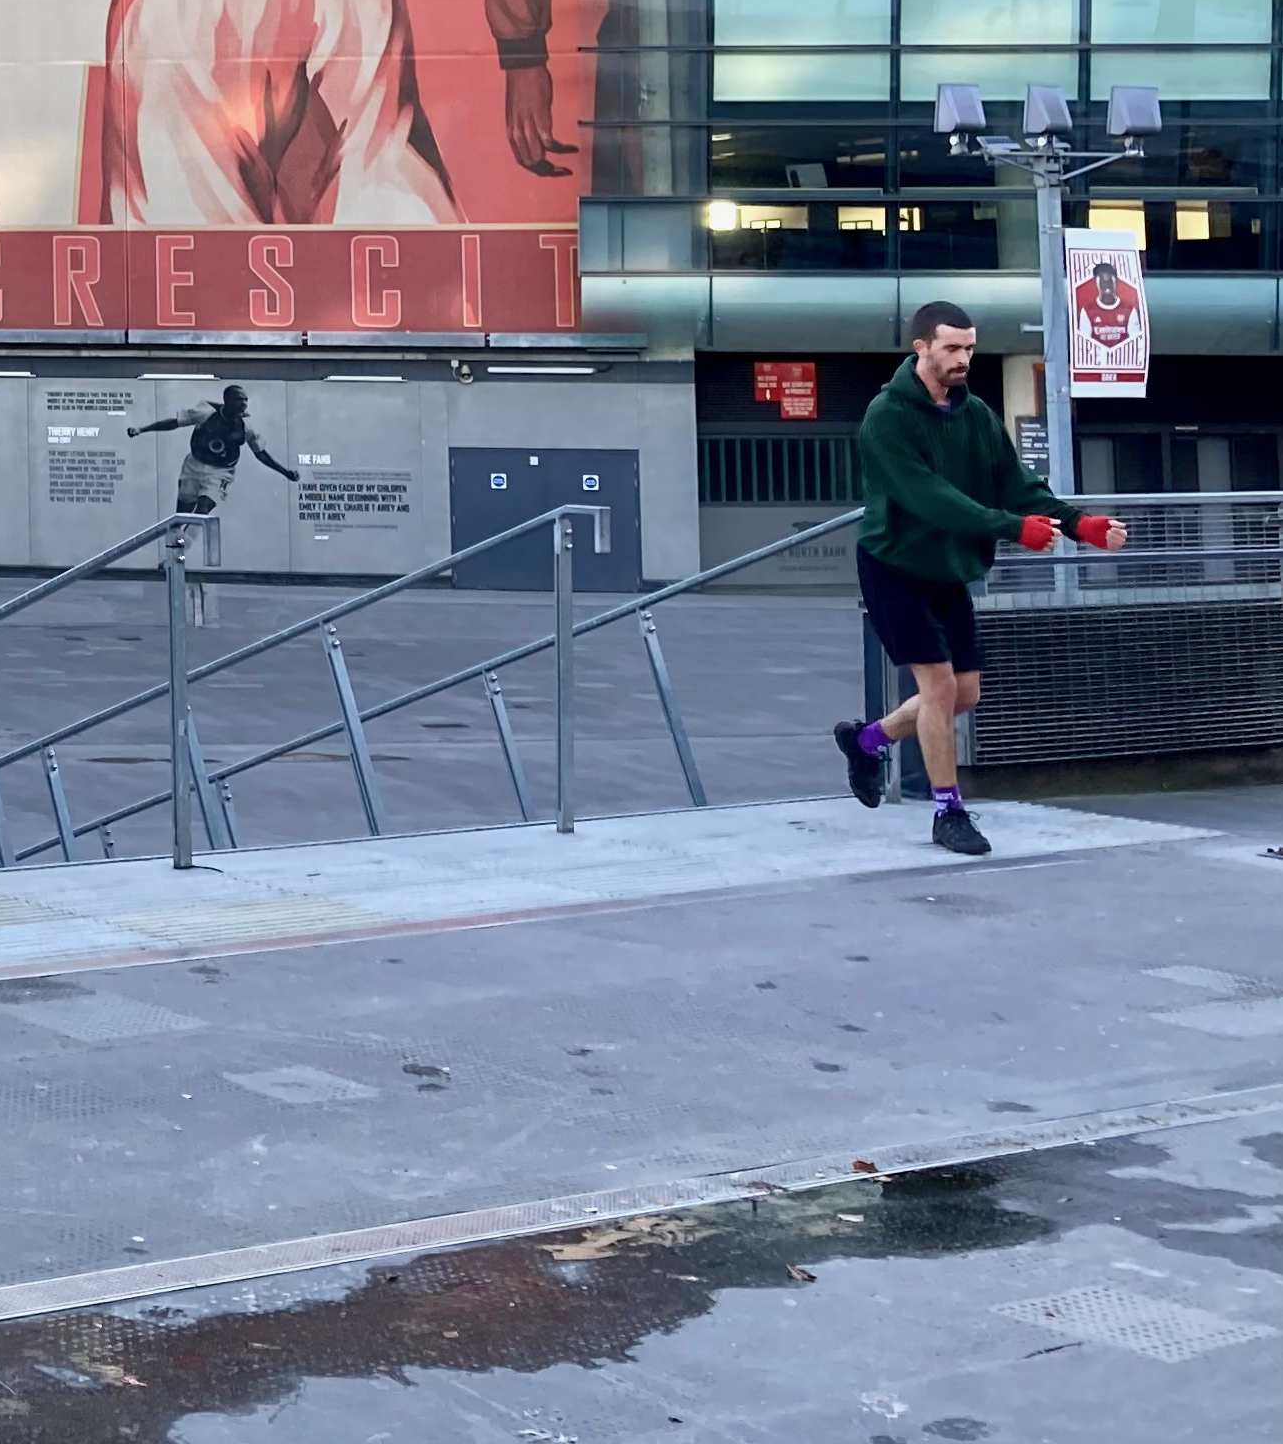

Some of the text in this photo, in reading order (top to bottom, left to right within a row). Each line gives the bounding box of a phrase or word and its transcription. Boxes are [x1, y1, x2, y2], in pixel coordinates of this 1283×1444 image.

[77, 426, 100, 436] HENRY
[298, 454, 331, 464] THE FANS
[302, 484, 318, 493] HAVE
[319, 484, 338, 493] GIVEN
[339, 484, 355, 493] EACH
[357, 484, 364, 493] OF
[366, 484, 376, 493] MY
[377, 484, 408, 493] CHILDREN
[299, 493, 303, 502] A
[328, 493, 345, 502] NAME
[381, 493, 397, 502] WITH
[397, 503, 410, 512] AND
